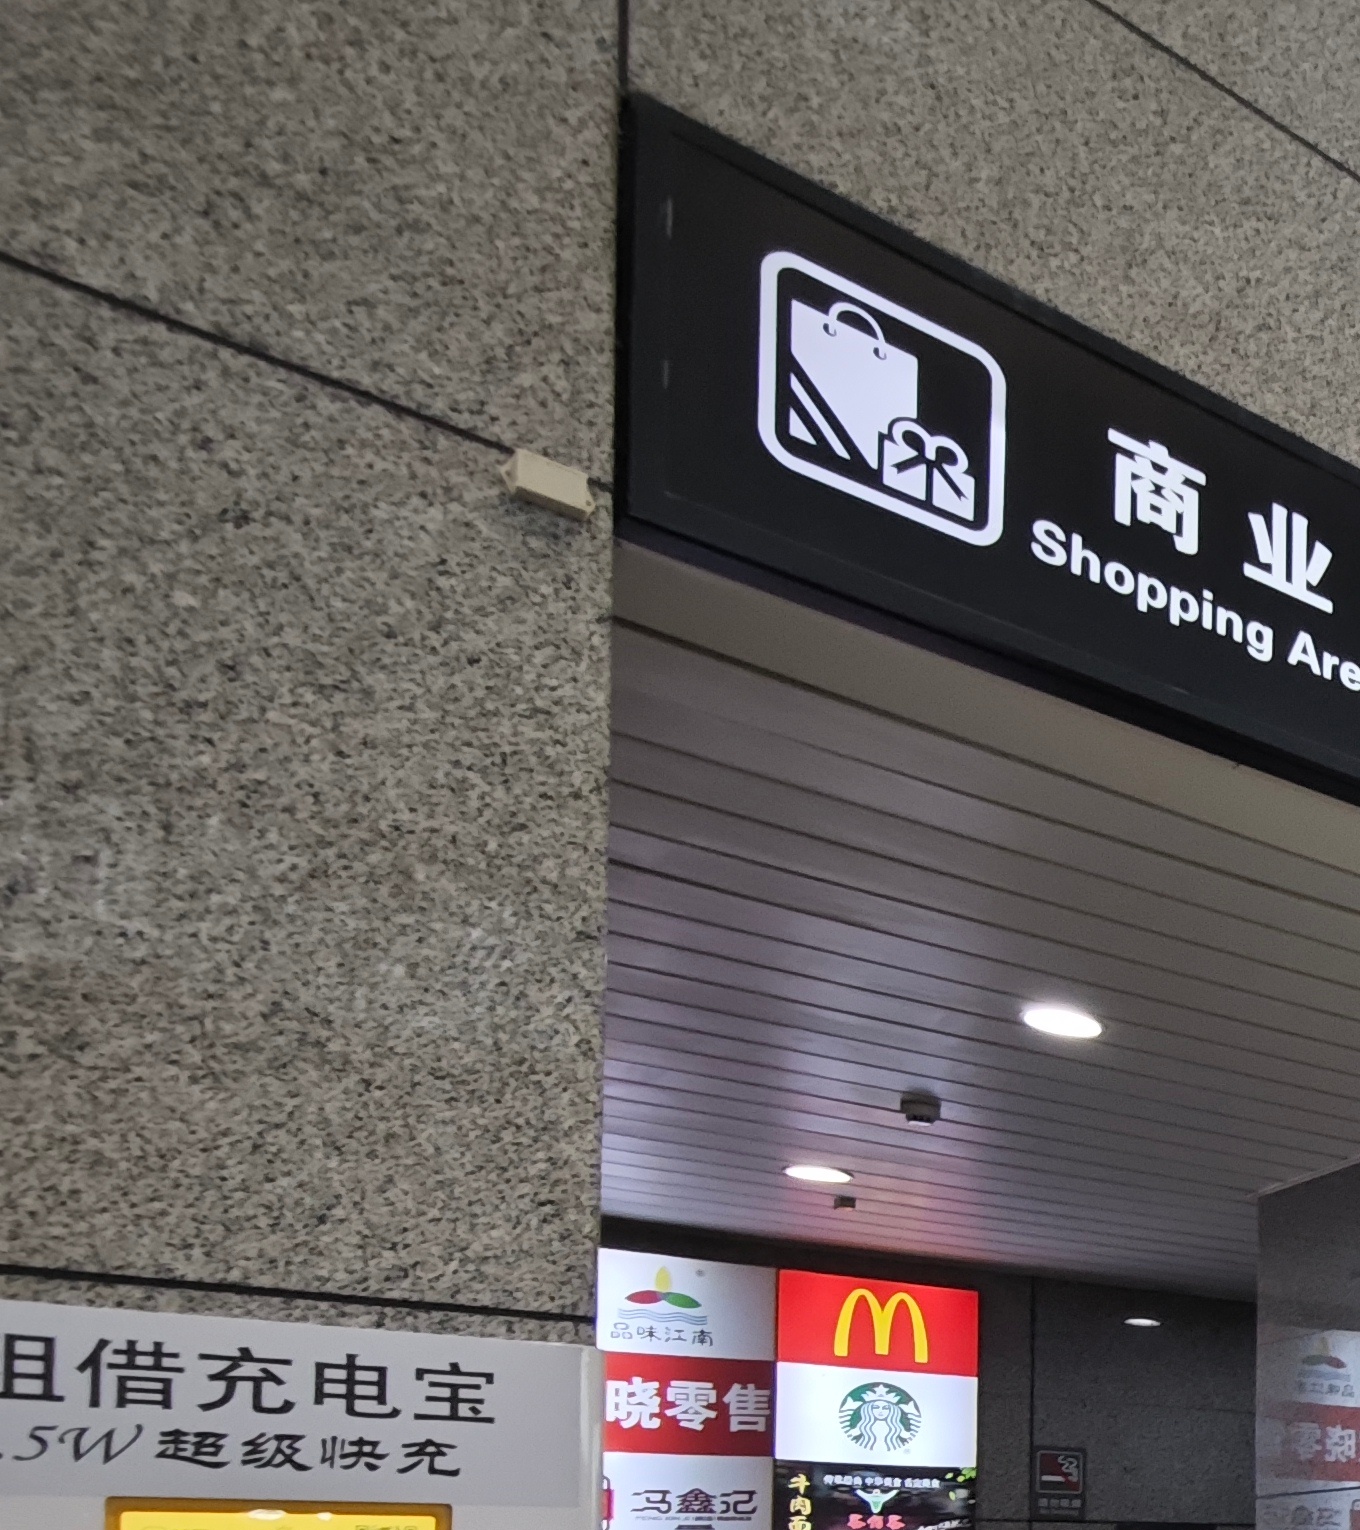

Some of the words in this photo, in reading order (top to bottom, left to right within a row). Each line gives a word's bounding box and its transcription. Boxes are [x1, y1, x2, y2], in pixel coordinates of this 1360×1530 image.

[1107, 427, 1334, 614] 商业
[1032, 518, 1274, 662] Shopping
[609, 1321, 715, 1347] 品味江南
[154, 1427, 462, 1478] 超级快充
